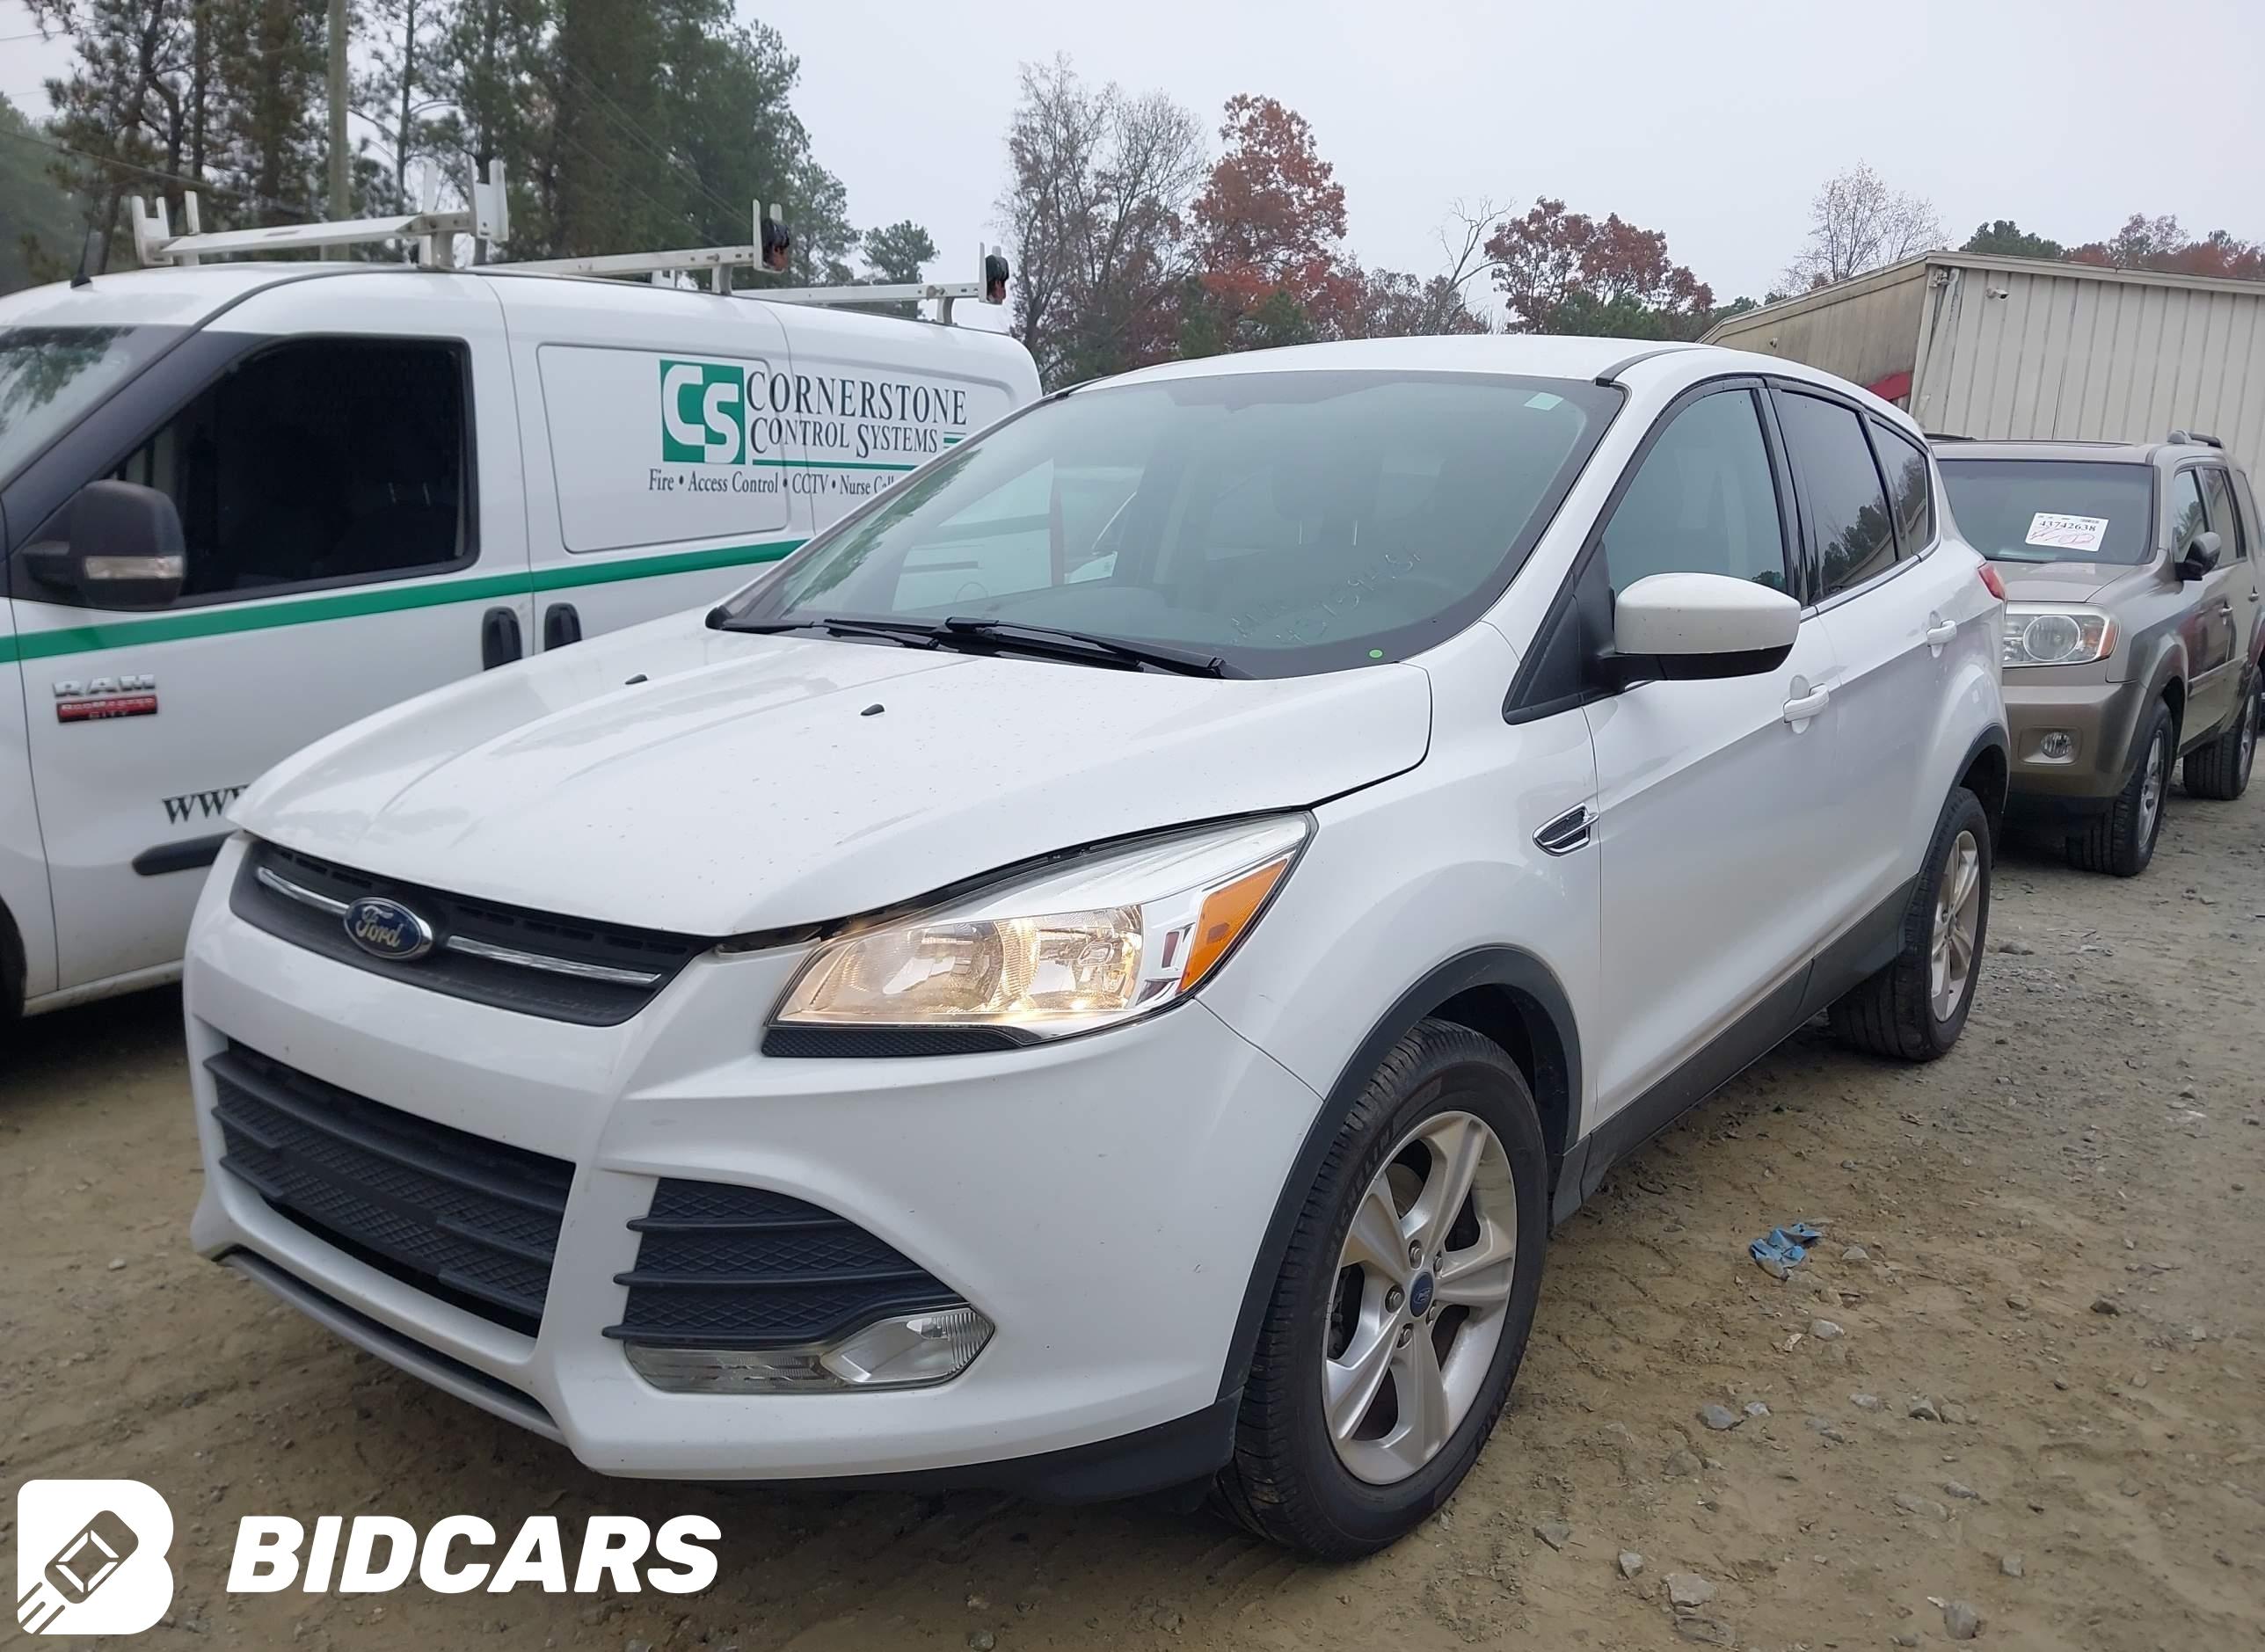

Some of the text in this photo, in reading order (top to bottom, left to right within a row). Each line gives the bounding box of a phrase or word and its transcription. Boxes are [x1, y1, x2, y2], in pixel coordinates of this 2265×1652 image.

[662, 364, 741, 464] CS
[747, 370, 967, 426] CORNERSTONE
[750, 417, 938, 458] CONTROL SYSTEMS
[649, 468, 674, 491] Fire
[688, 470, 728, 492] Access
[732, 470, 778, 493] Control
[792, 473, 830, 495] CCTV
[840, 475, 870, 495] Nurse
[2040, 520, 2097, 532] 43742638
[53, 674, 156, 697] RAM
[355, 906, 405, 948] Ford
